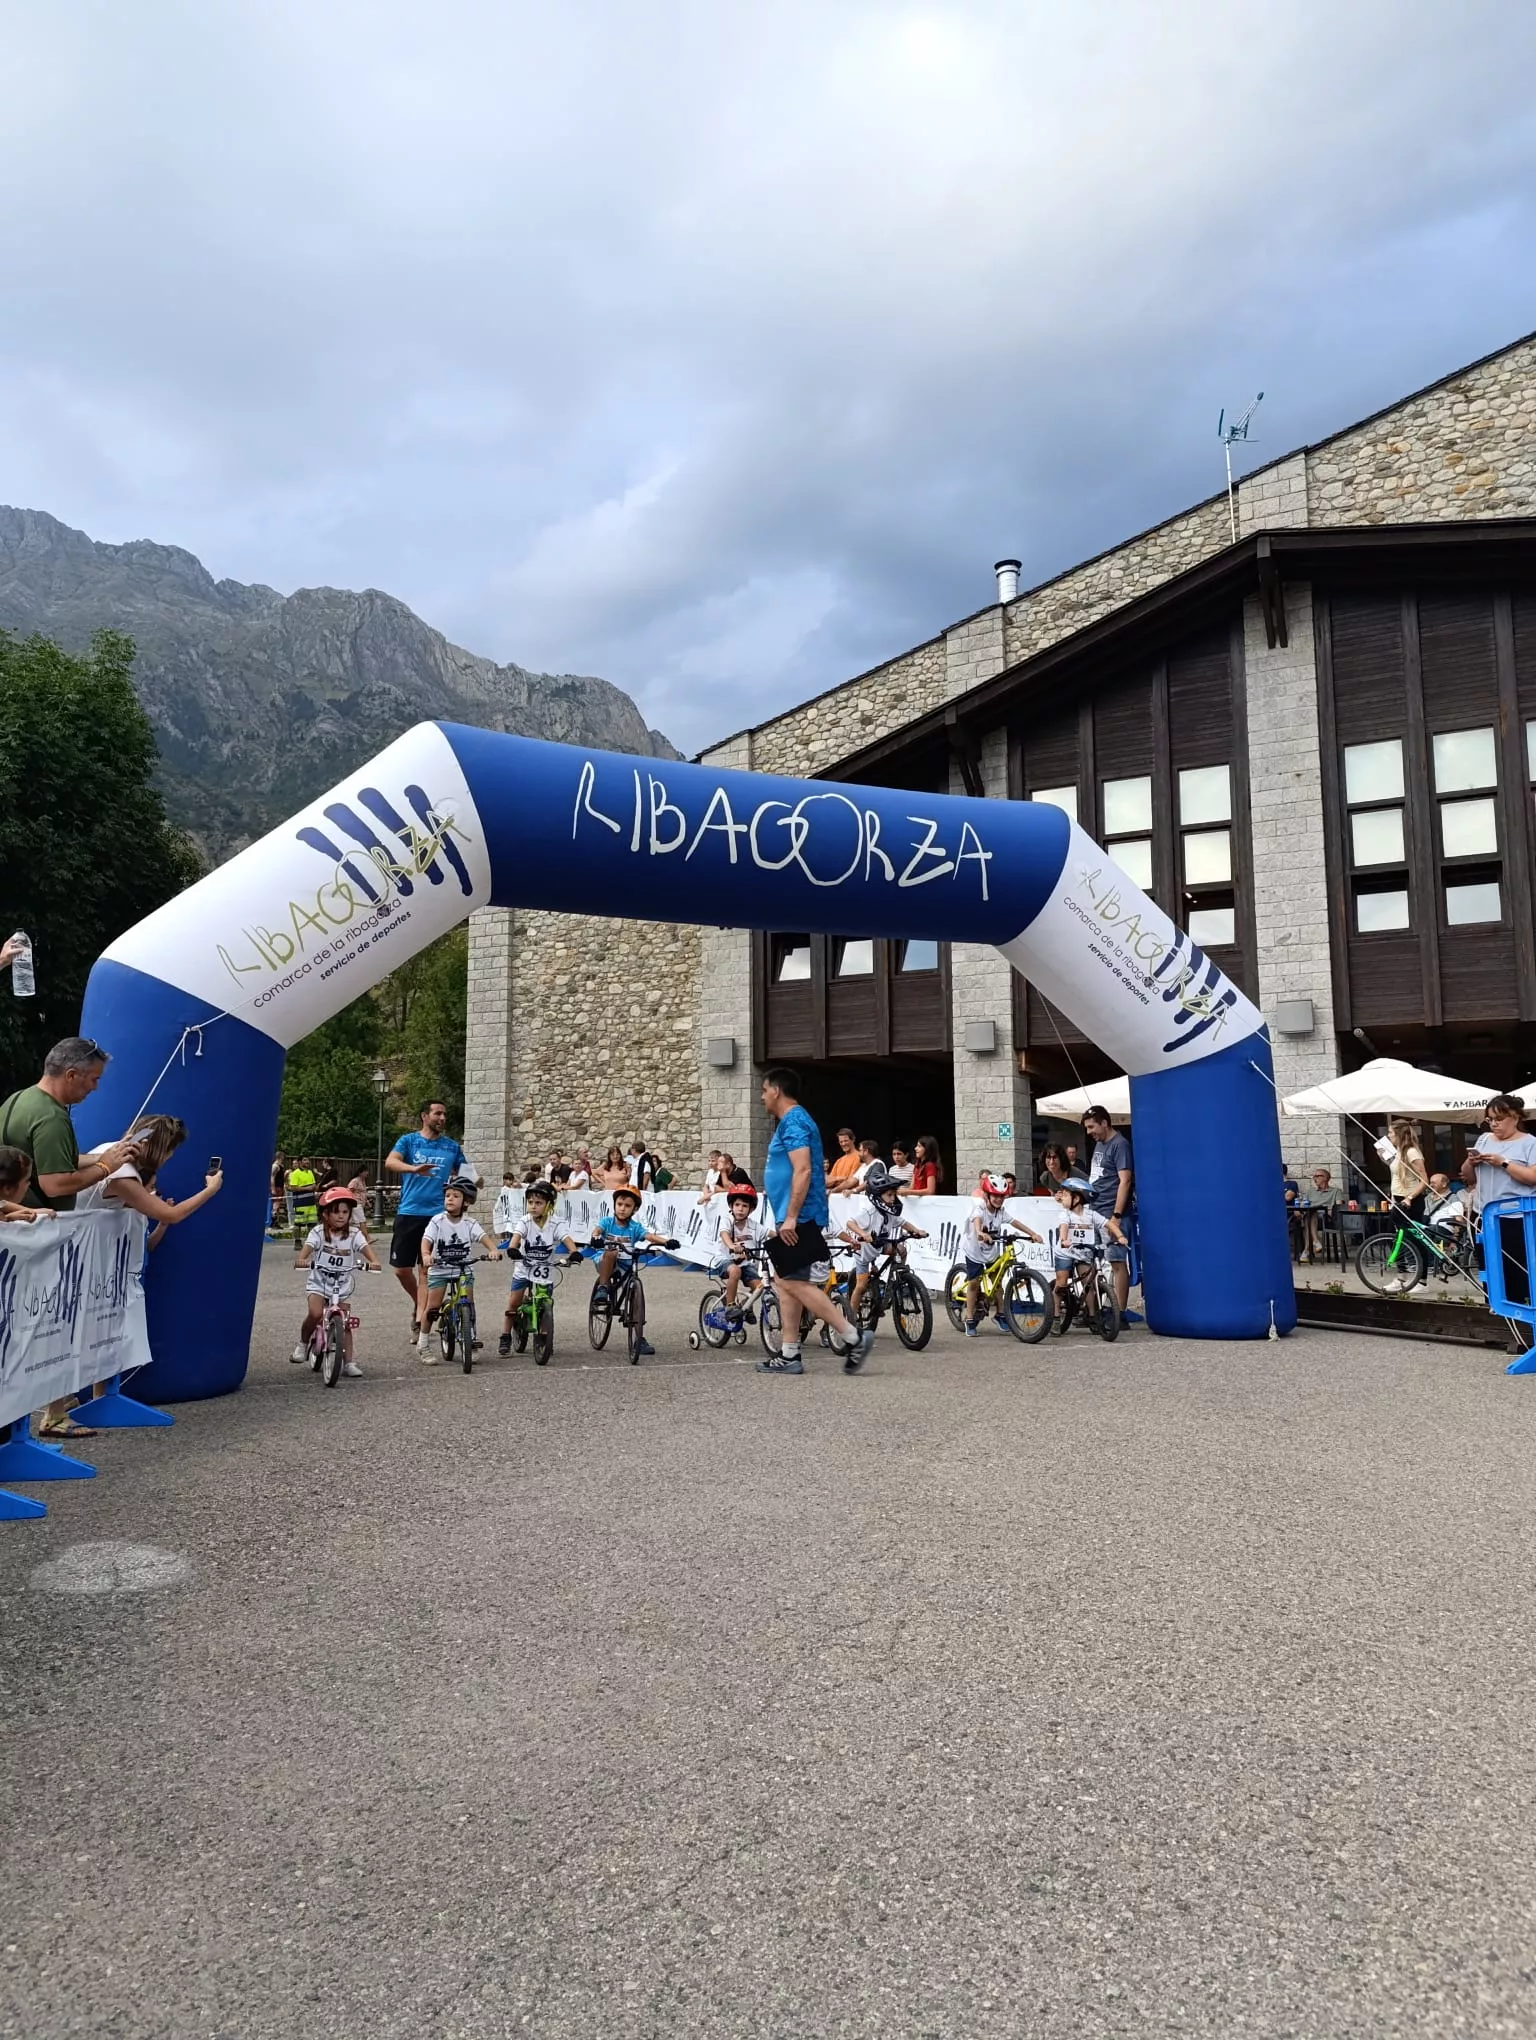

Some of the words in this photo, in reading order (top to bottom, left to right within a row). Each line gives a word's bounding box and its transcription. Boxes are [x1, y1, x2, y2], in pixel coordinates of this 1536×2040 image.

[573, 761, 992, 901] RIBAGORZA
[216, 808, 472, 989] RIBAGORZA
[253, 962, 312, 1008] comarca
[313, 950, 332, 965] de
[330, 939, 346, 952] la
[345, 898, 402, 941] ribagoza
[320, 952, 356, 981] servicio
[357, 941, 370, 954] de
[371, 911, 412, 945] deportes
[1063, 896, 1102, 936] comarca
[1100, 935, 1114, 948] de
[1113, 945, 1123, 957] la
[1122, 955, 1160, 995] ribagoza
[1077, 869, 1227, 1041] RIBAGORZA
[1087, 943, 1113, 968] servicio
[1112, 967, 1123, 978] de
[1121, 976, 1150, 1005] deportes
[1452, 1099, 1488, 1109] AMBAR
[327, 1255, 344, 1267] 40
[1073, 1229, 1086, 1238] 43
[533, 1266, 550, 1279] 63
